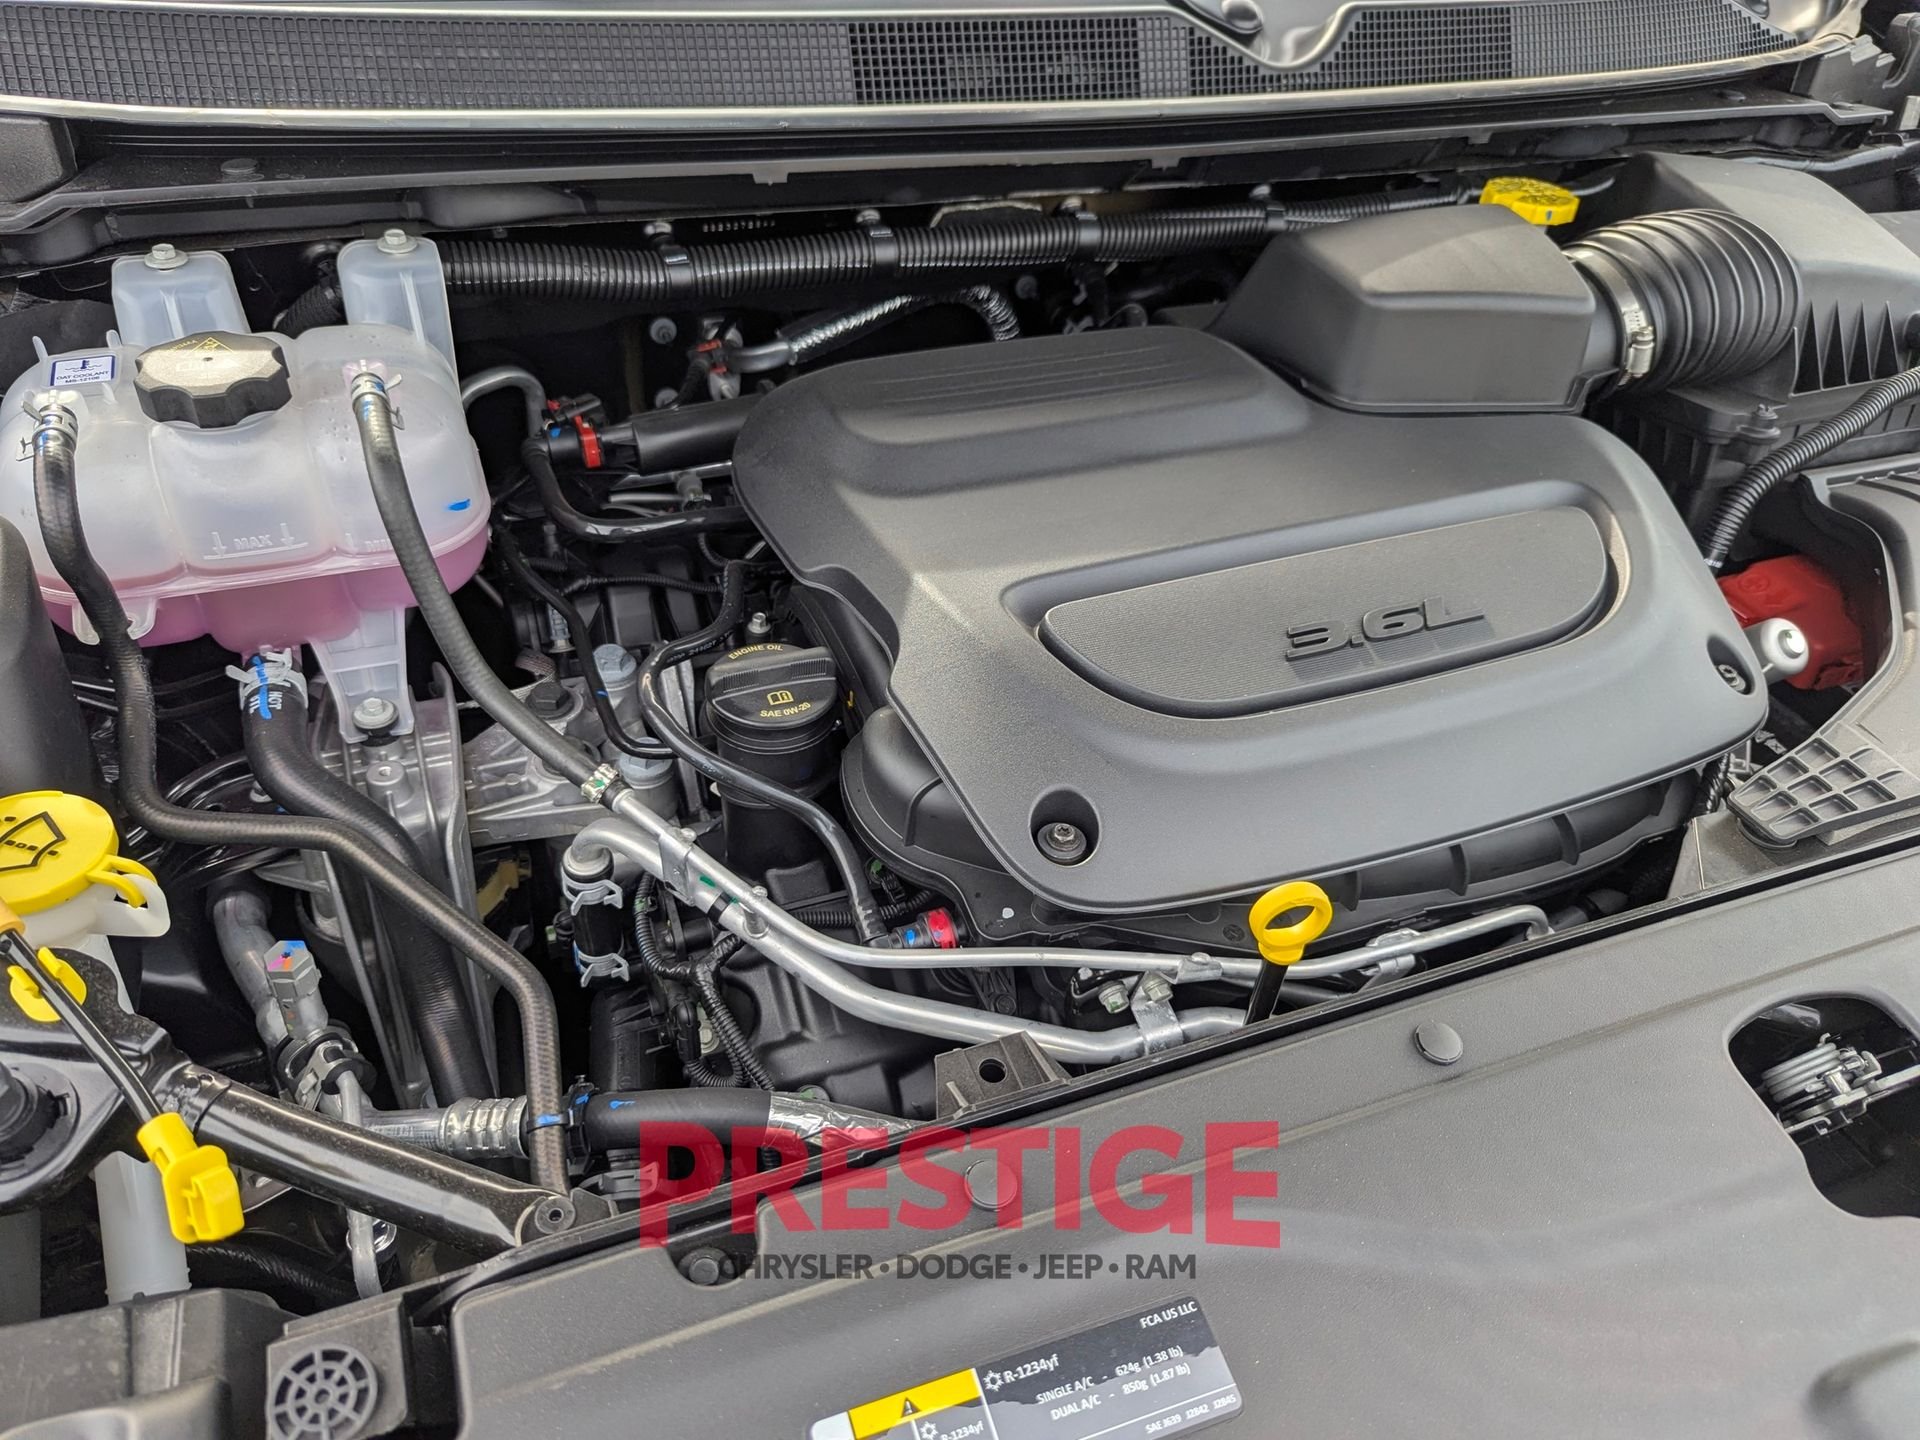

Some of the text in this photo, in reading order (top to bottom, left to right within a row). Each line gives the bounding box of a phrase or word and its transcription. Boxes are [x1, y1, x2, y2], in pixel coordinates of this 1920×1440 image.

[73, 370, 109, 379] COOLANT
[233, 534, 273, 551] MAX
[1285, 595, 1485, 662] 3.6L
[728, 644, 784, 660] ENGINE OIL
[268, 691, 283, 710] HOT
[760, 702, 811, 718] SAE 0W-20
[1139, 1301, 1198, 1329] FCA US LLC
[1003, 1353, 1059, 1384] R-1234yf
[1036, 1383, 1074, 1405] SINGLE
[1074, 1376, 1095, 1391] A/C
[1115, 1361, 1141, 1376] 624g
[1142, 1350, 1169, 1369] (1.38
[1169, 1345, 1184, 1357] lb)
[1050, 1401, 1081, 1421] DUAL
[1081, 1394, 1102, 1410] A/C
[1122, 1379, 1149, 1395] 850g
[1149, 1368, 1175, 1386] (1.87
[1175, 1362, 1191, 1375] lb)
[941, 1420, 985, 1440] R-1234yf
[1145, 1420, 1162, 1434] SAE
